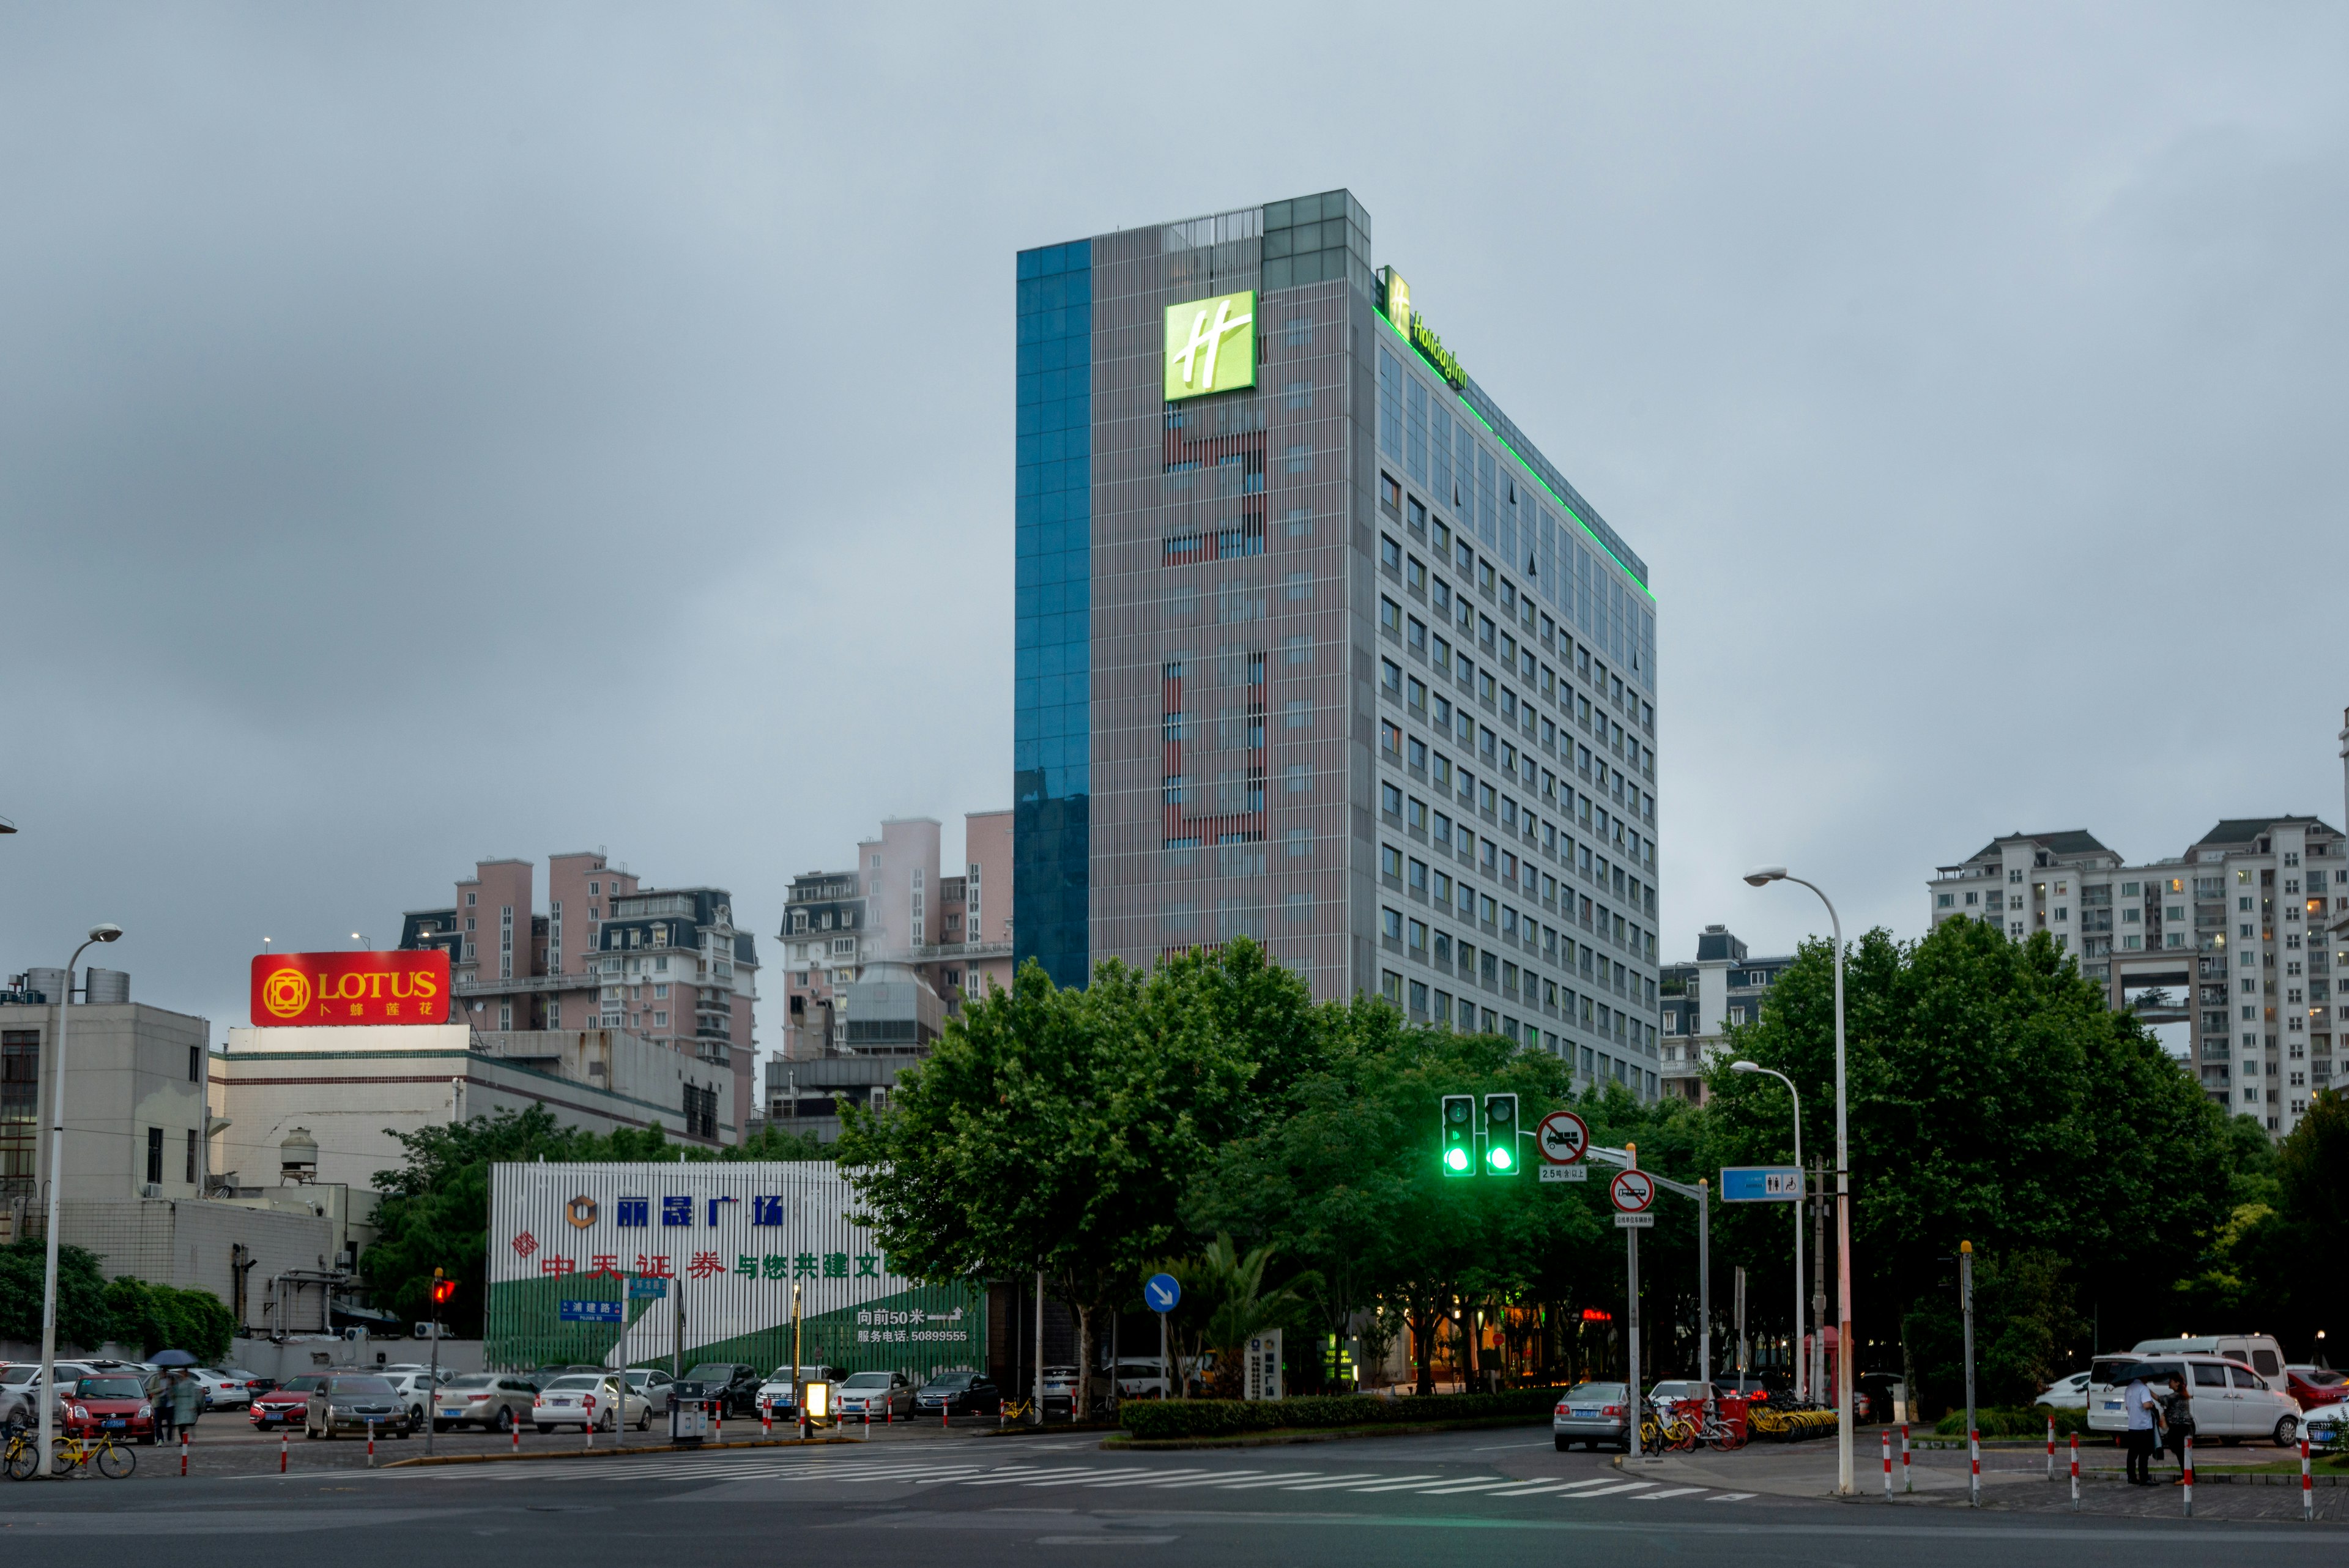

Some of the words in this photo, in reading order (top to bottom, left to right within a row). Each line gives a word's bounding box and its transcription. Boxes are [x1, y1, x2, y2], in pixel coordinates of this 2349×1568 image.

[1414, 311, 1452, 379] Holiday
[1452, 351, 1468, 389] Inn
[317, 971, 437, 999] LOTUS
[320, 1001, 433, 1016] 卜蜂莲花
[618, 1195, 784, 1227] 丽晟广场
[541, 1251, 726, 1282] 中天证券
[735, 1251, 908, 1280] 与您共建文
[573, 1302, 610, 1313] 浦建路
[857, 1308, 925, 1326] 向前50米
[911, 1330, 967, 1342] 50899555
